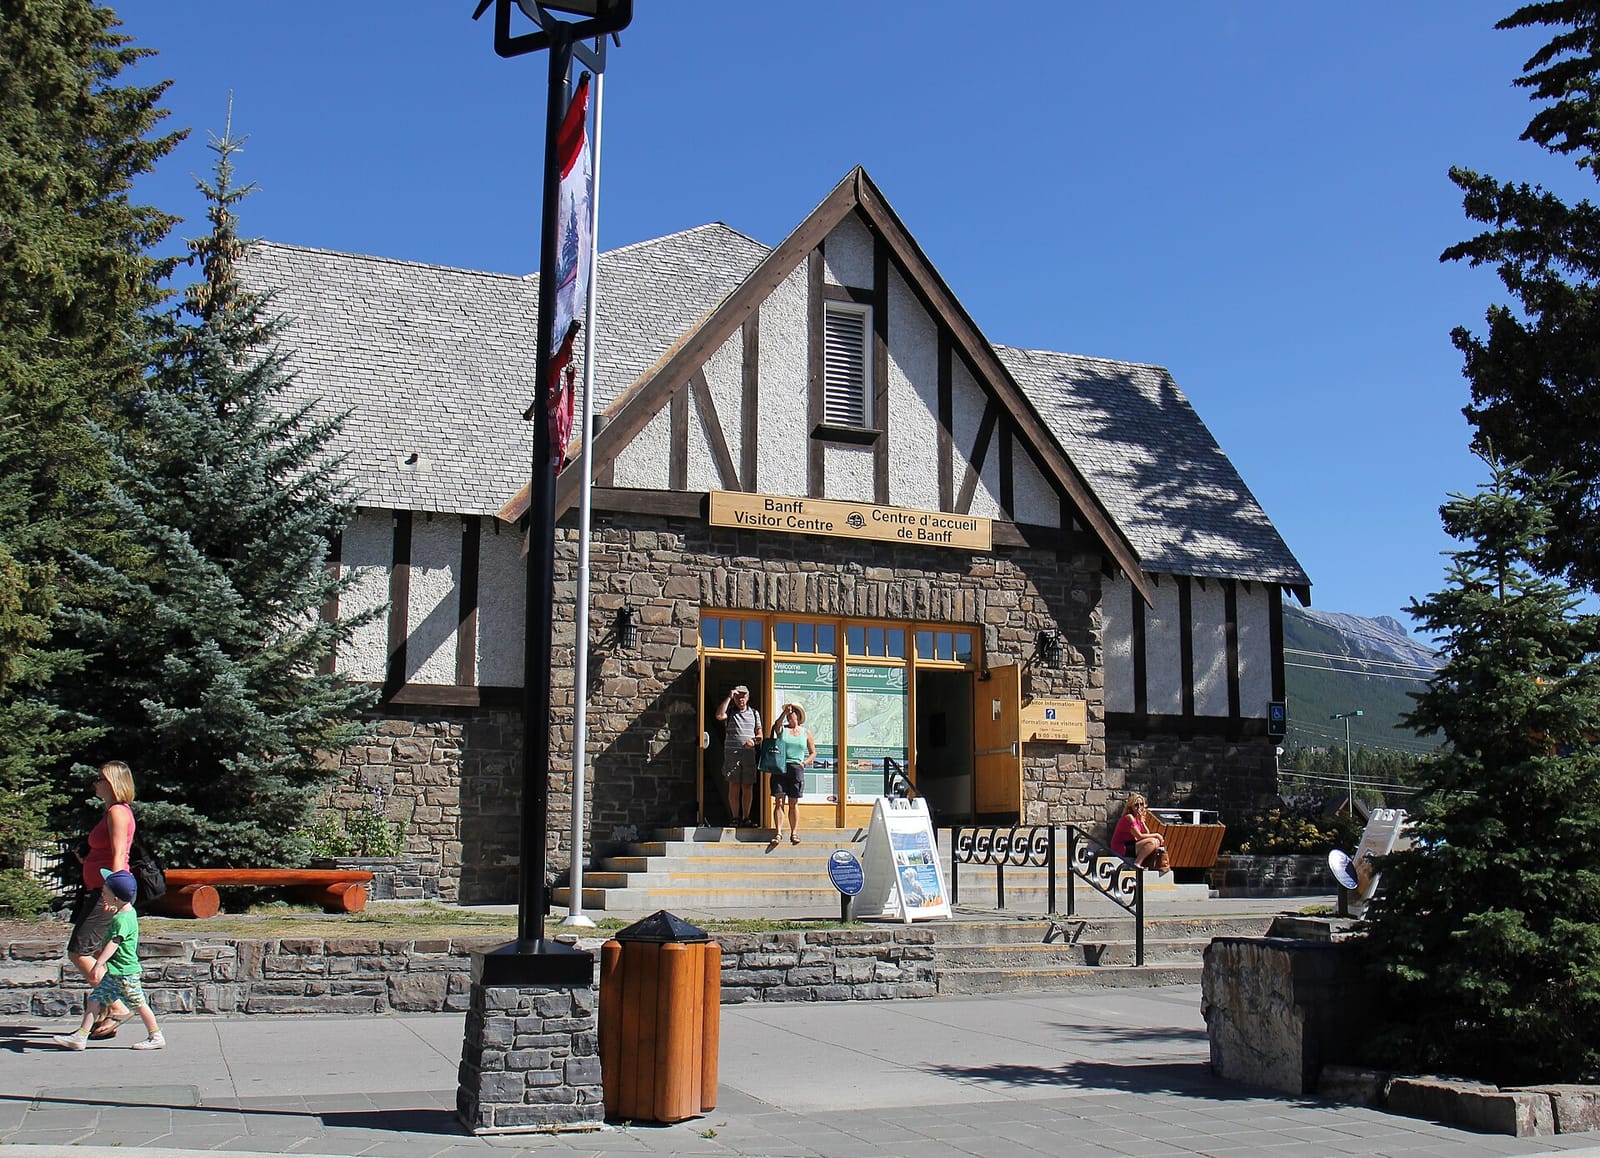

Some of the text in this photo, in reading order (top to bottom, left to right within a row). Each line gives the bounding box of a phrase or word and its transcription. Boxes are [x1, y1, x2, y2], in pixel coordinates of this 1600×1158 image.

[764, 499, 804, 514] Banff
[734, 511, 833, 531] Visitor Centre
[872, 509, 977, 531] Centre d'accueil
[897, 527, 953, 542] de Banff
[774, 662, 800, 670] Welcome
